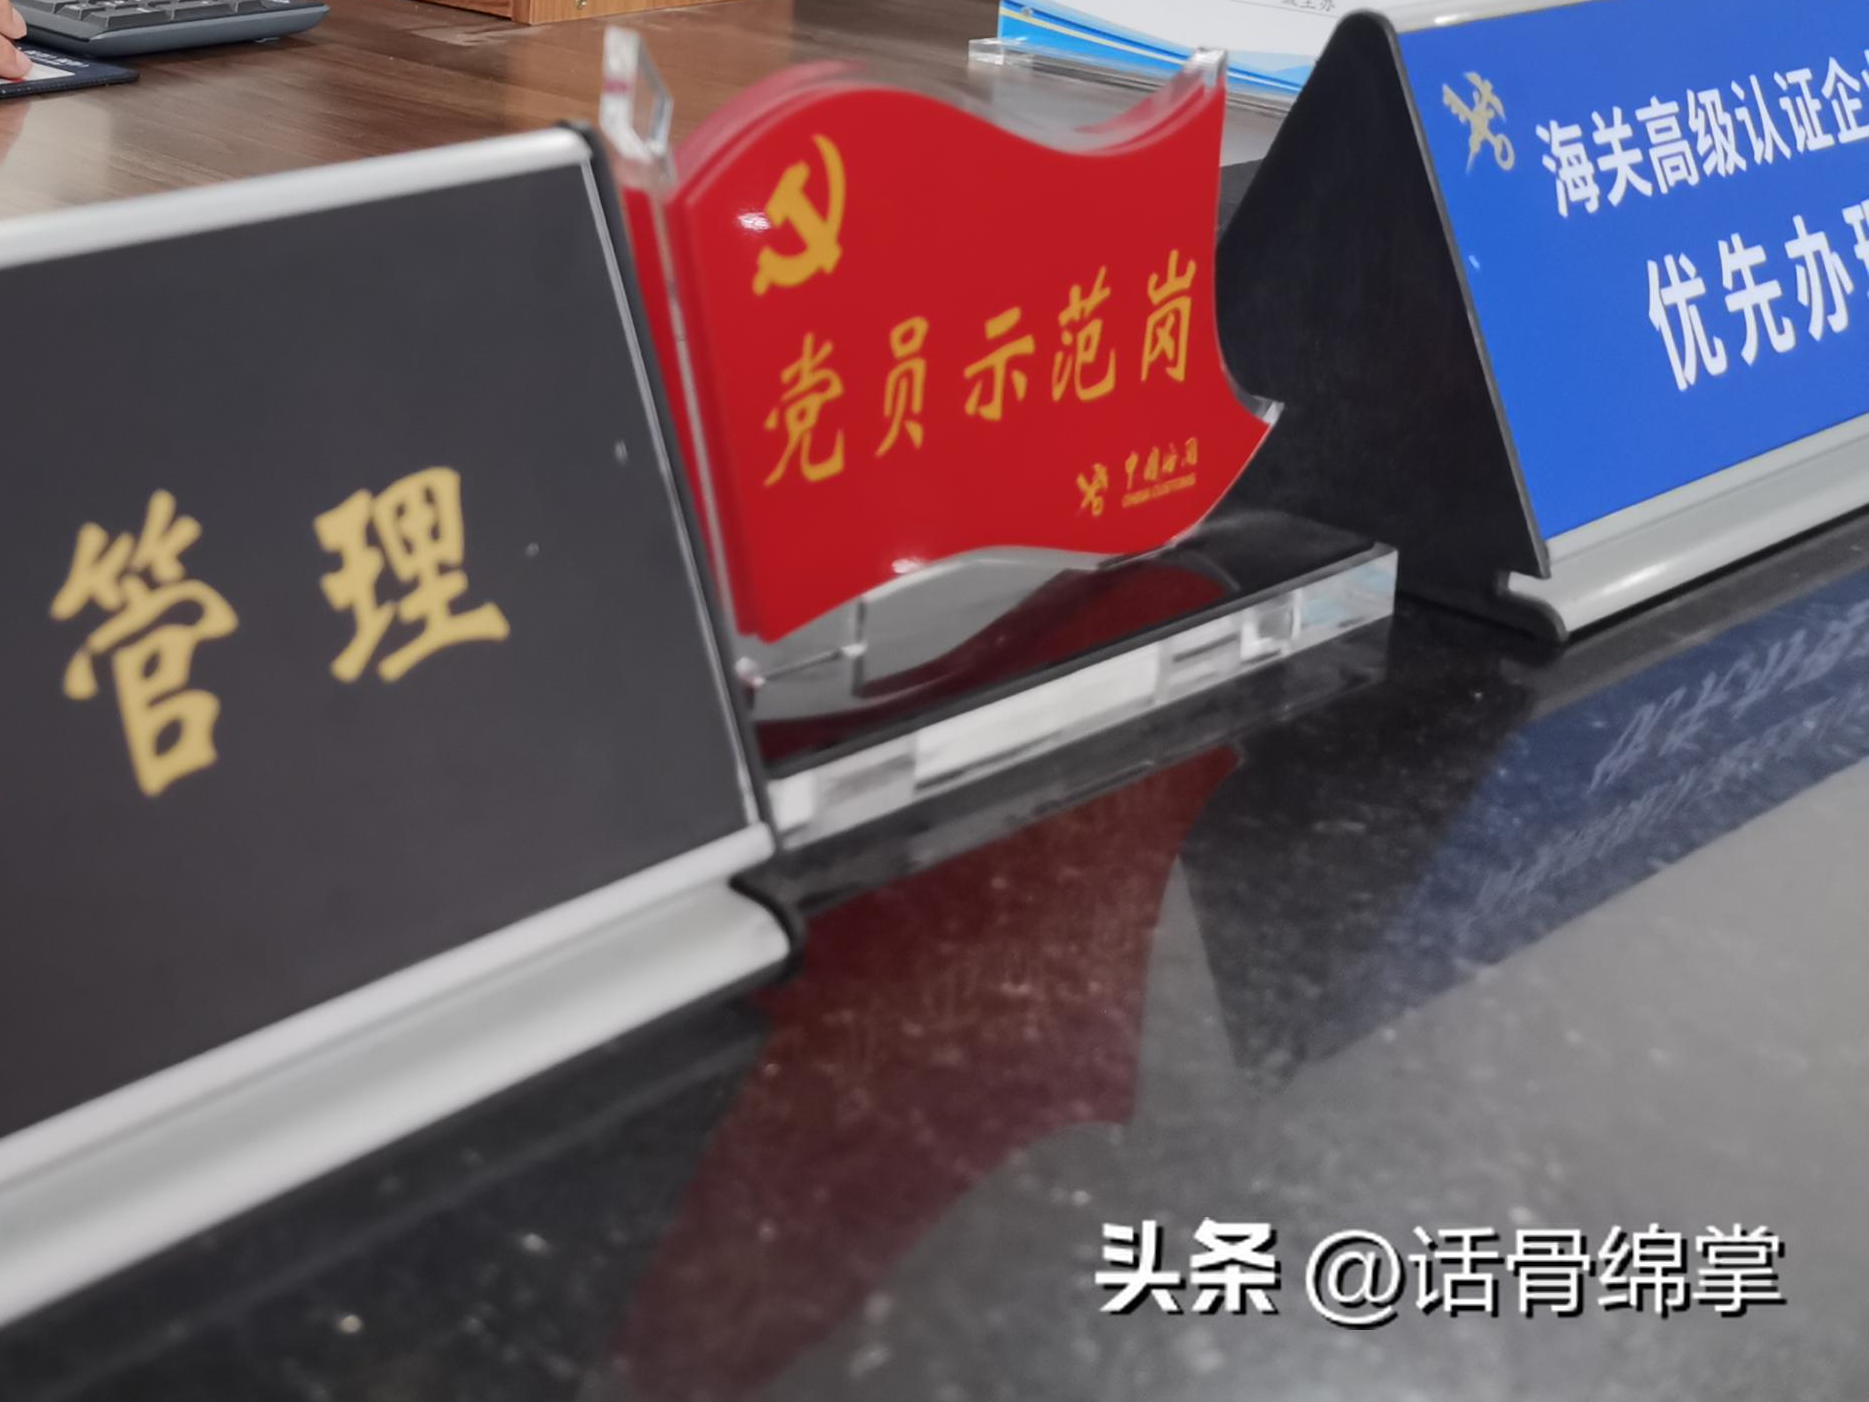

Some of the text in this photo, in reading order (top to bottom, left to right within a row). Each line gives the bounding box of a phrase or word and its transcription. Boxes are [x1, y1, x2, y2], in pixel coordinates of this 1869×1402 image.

[1535, 49, 1869, 218] 海关高级认证企
[763, 249, 1197, 487] 党员示范岗
